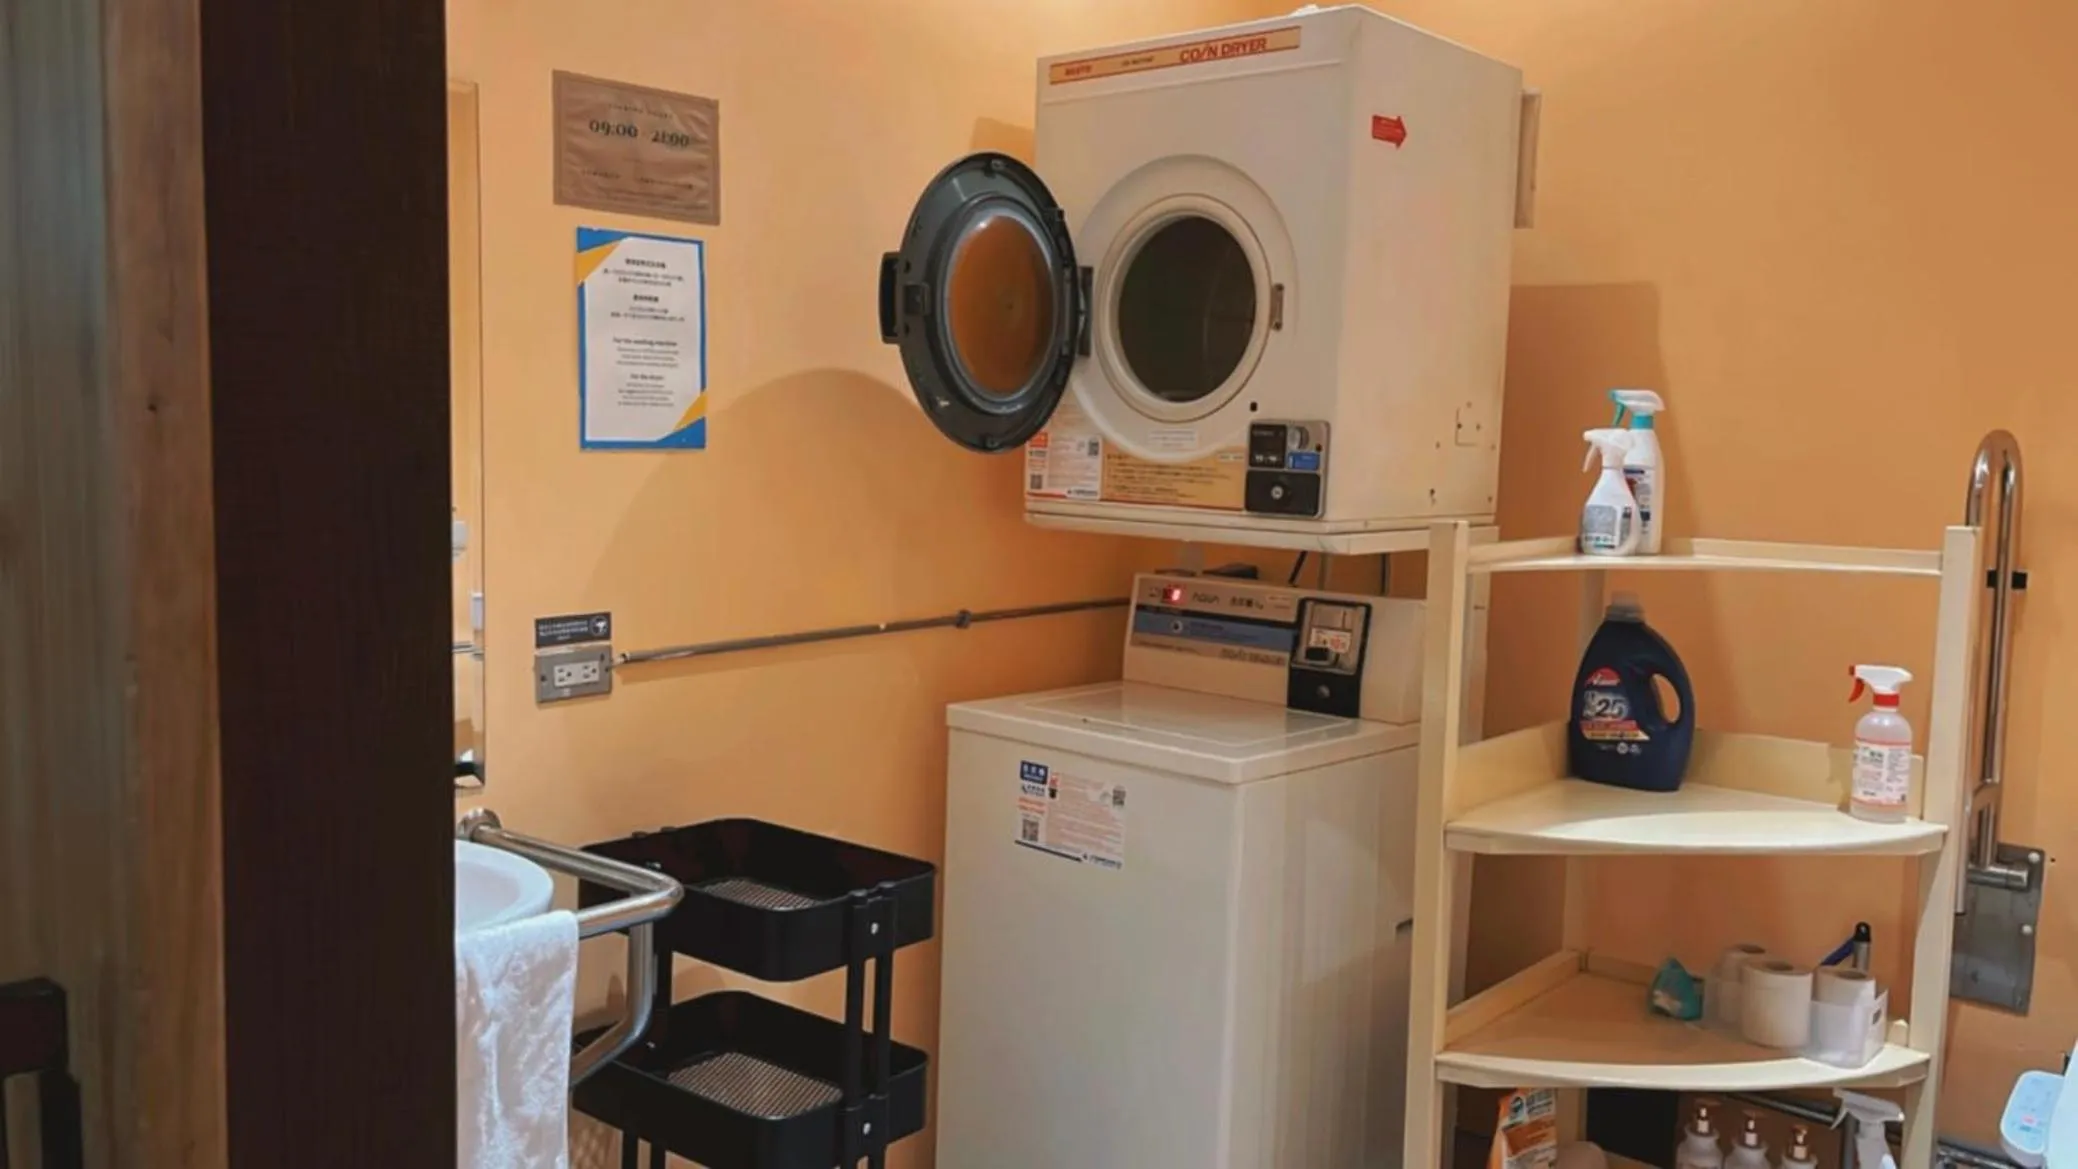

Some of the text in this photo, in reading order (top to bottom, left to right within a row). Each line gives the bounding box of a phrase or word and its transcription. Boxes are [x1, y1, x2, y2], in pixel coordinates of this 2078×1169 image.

[1222, 38, 1267, 56] DRYER
[589, 119, 689, 147] 09:00 21:00
